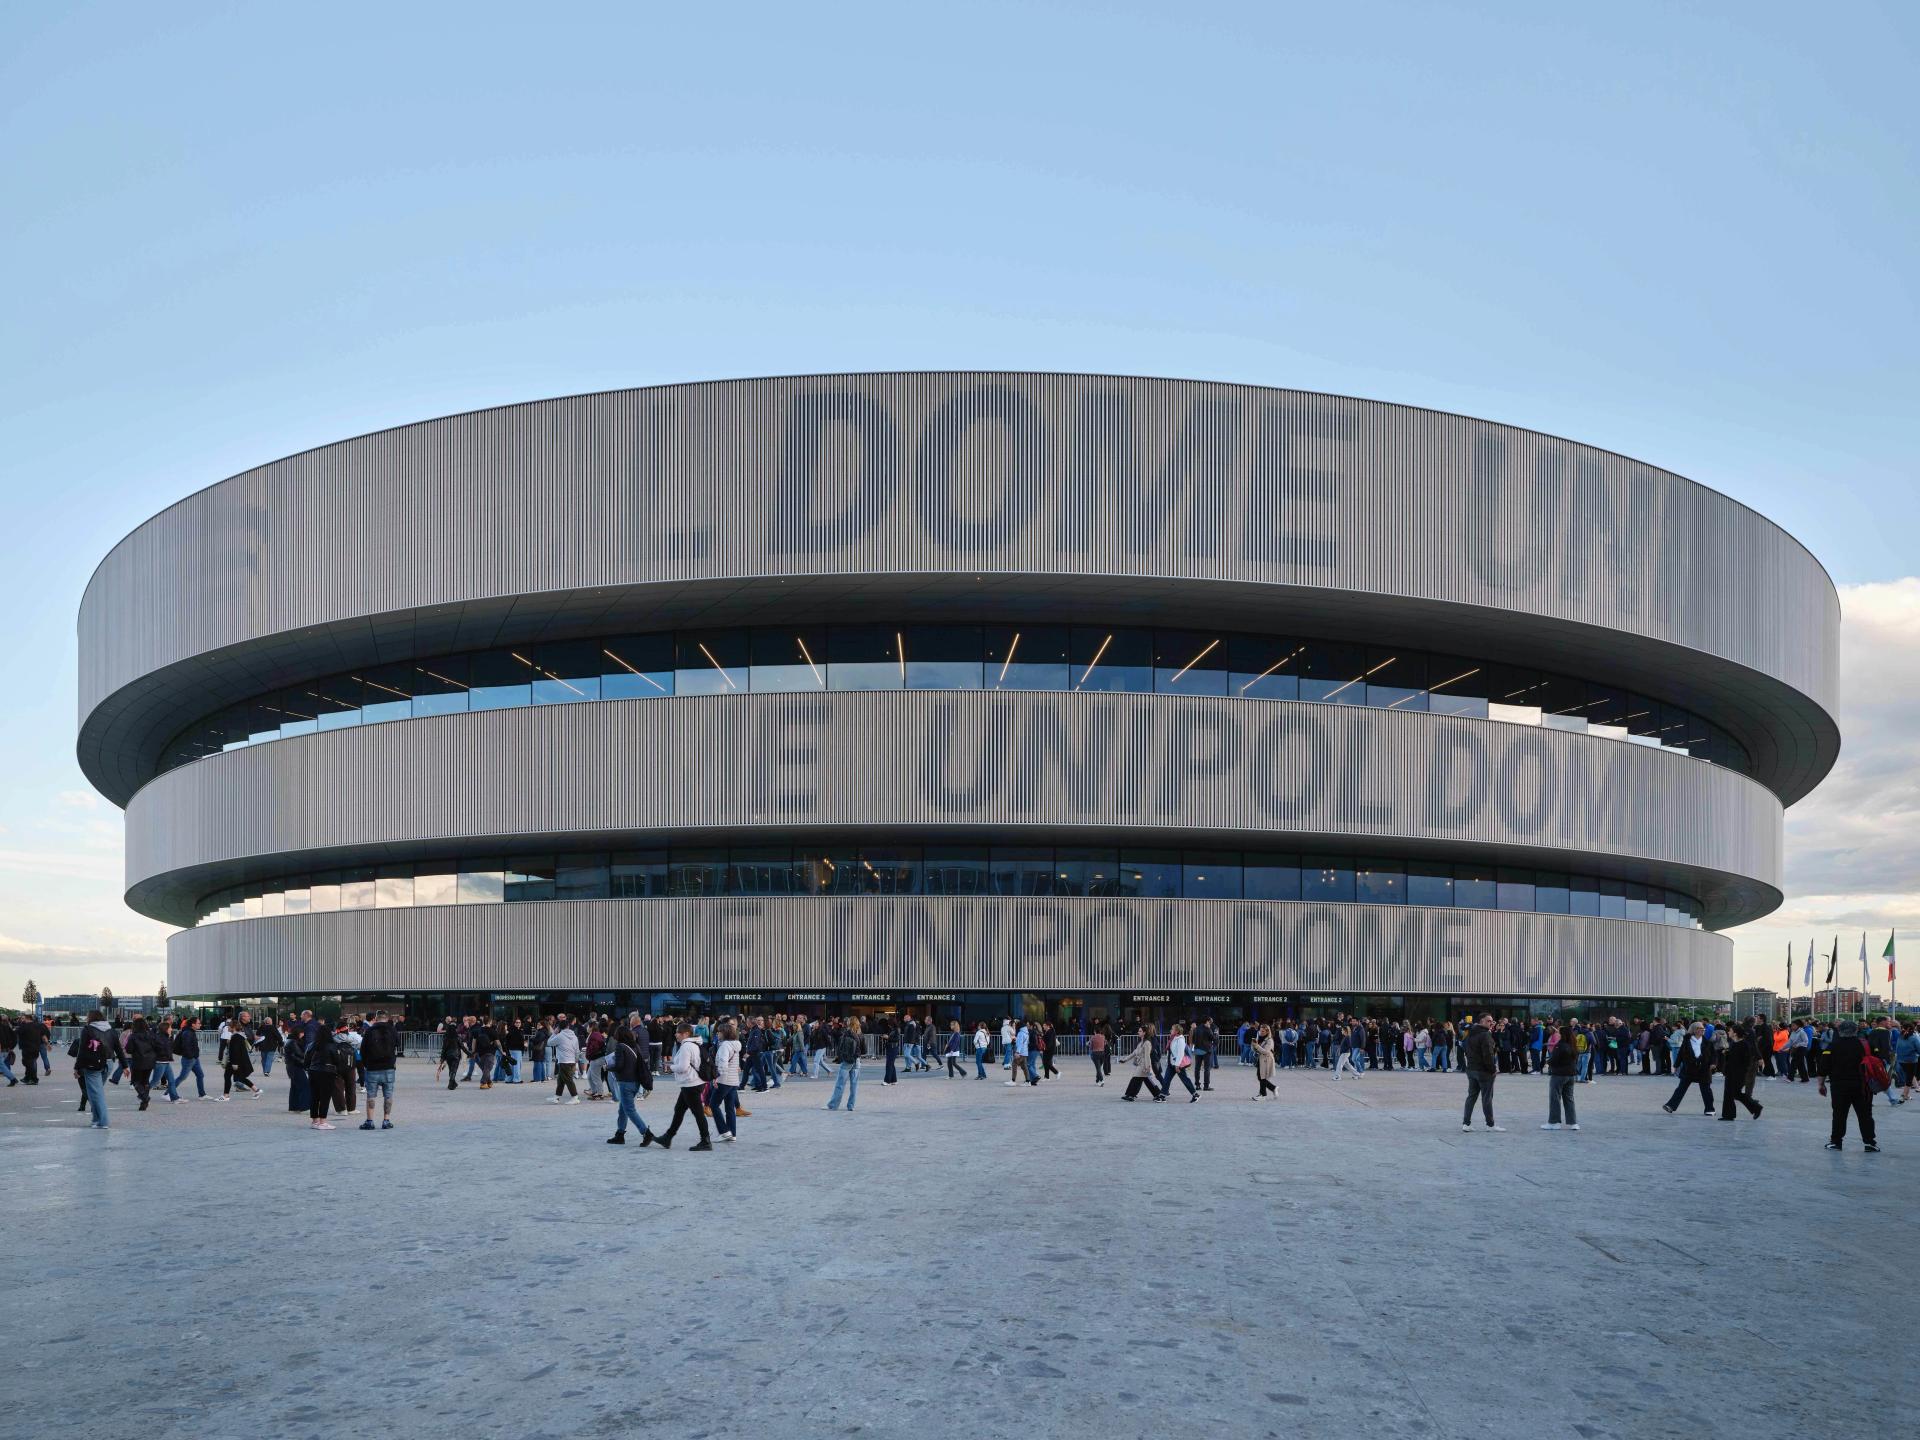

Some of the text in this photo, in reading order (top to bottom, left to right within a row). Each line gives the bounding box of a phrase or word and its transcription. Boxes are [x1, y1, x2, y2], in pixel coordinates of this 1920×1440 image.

[764, 383, 1362, 571] DOME
[919, 698, 1395, 825] UNIPOL
[825, 899, 1198, 986] UNIPOL
[1222, 902, 1471, 988] DOME
